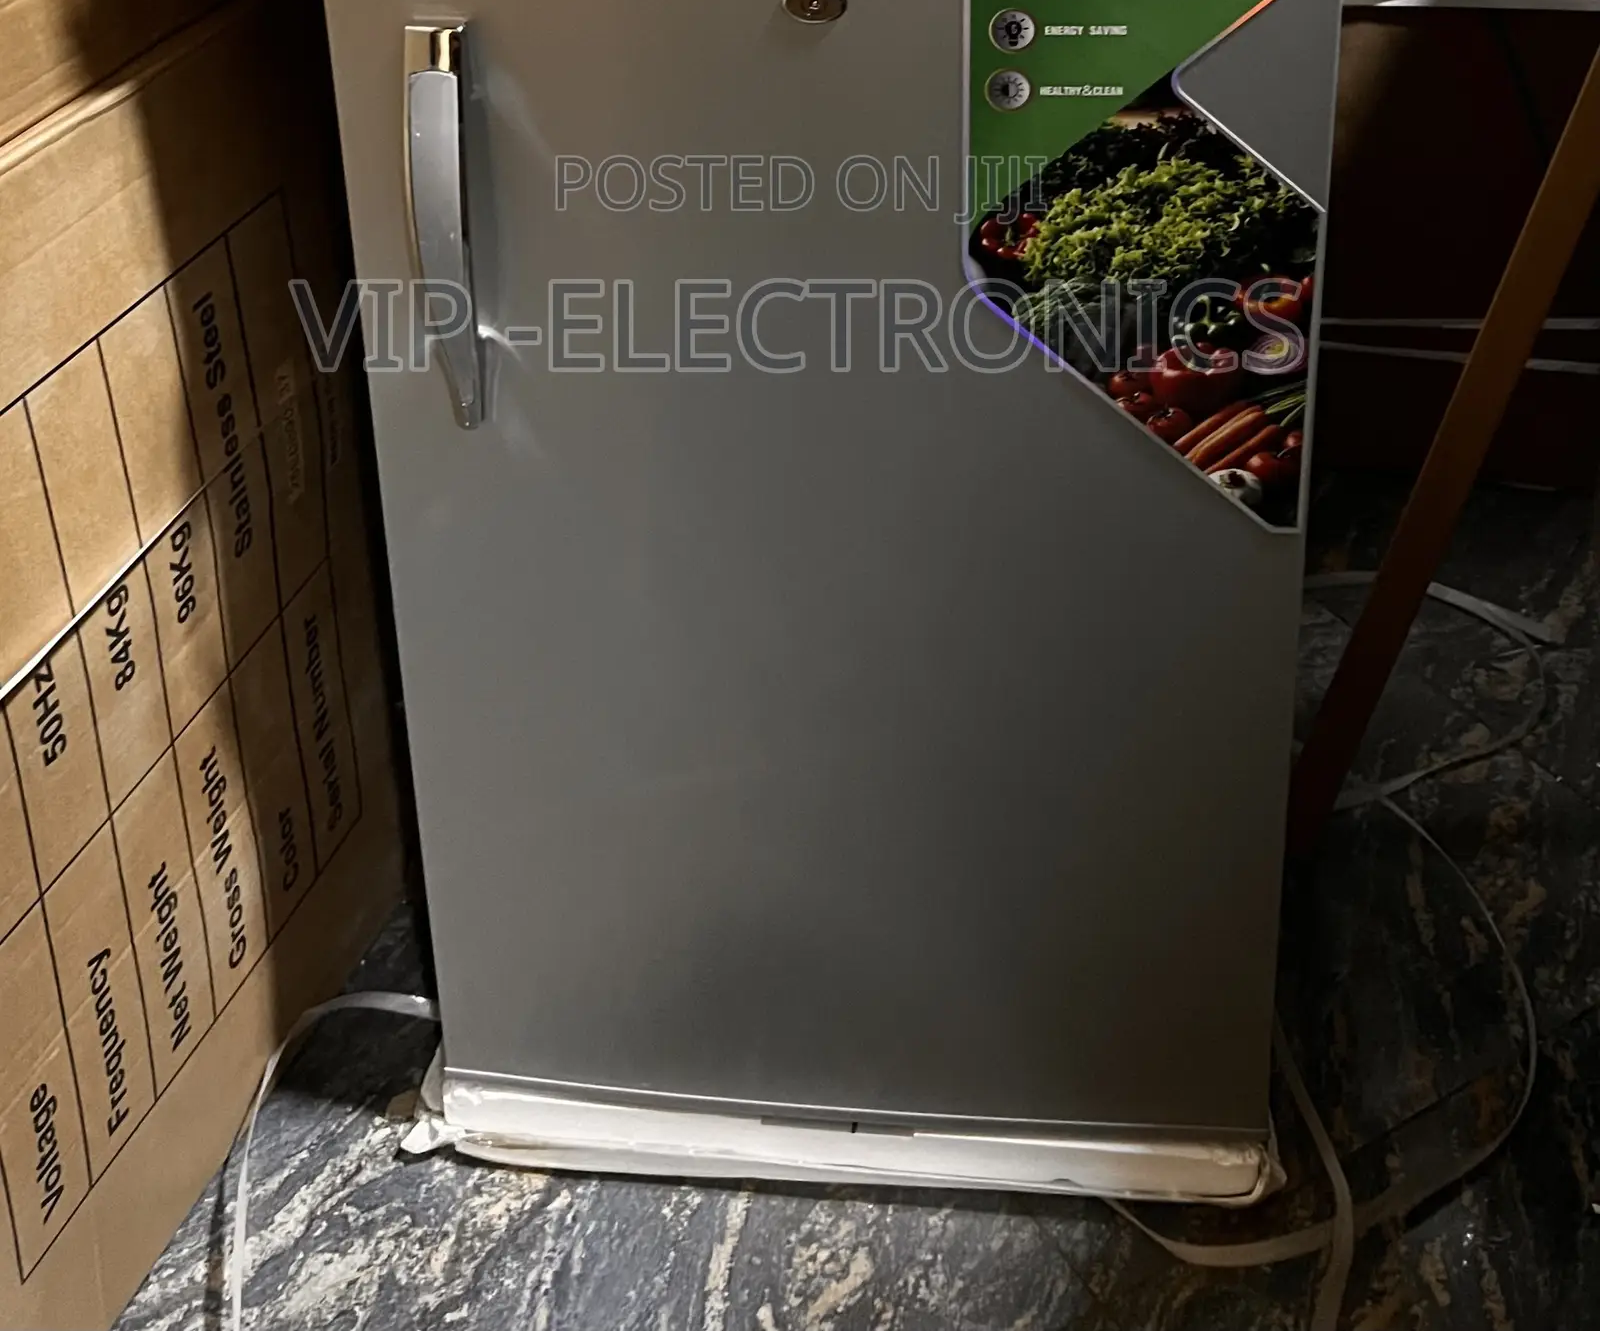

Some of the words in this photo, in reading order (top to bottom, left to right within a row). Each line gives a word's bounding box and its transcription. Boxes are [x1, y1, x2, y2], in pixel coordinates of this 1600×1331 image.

[1044, 25, 1084, 37] ENERGY
[1088, 25, 1128, 37] SAVING
[191, 291, 227, 390] Steel
[217, 392, 253, 558] Stainless
[169, 521, 197, 623] 96Kg
[105, 584, 136, 691] 84Kg
[303, 614, 331, 743] Number
[32, 660, 67, 767] 50Hz
[199, 746, 233, 875] Weight
[317, 739, 344, 832] Serial
[278, 807, 300, 891] Color
[146, 861, 184, 994] Weight
[224, 868, 247, 969] Gross
[87, 947, 130, 1138] Frequency
[168, 981, 192, 1053] Net
[29, 1083, 65, 1226] Voltage
